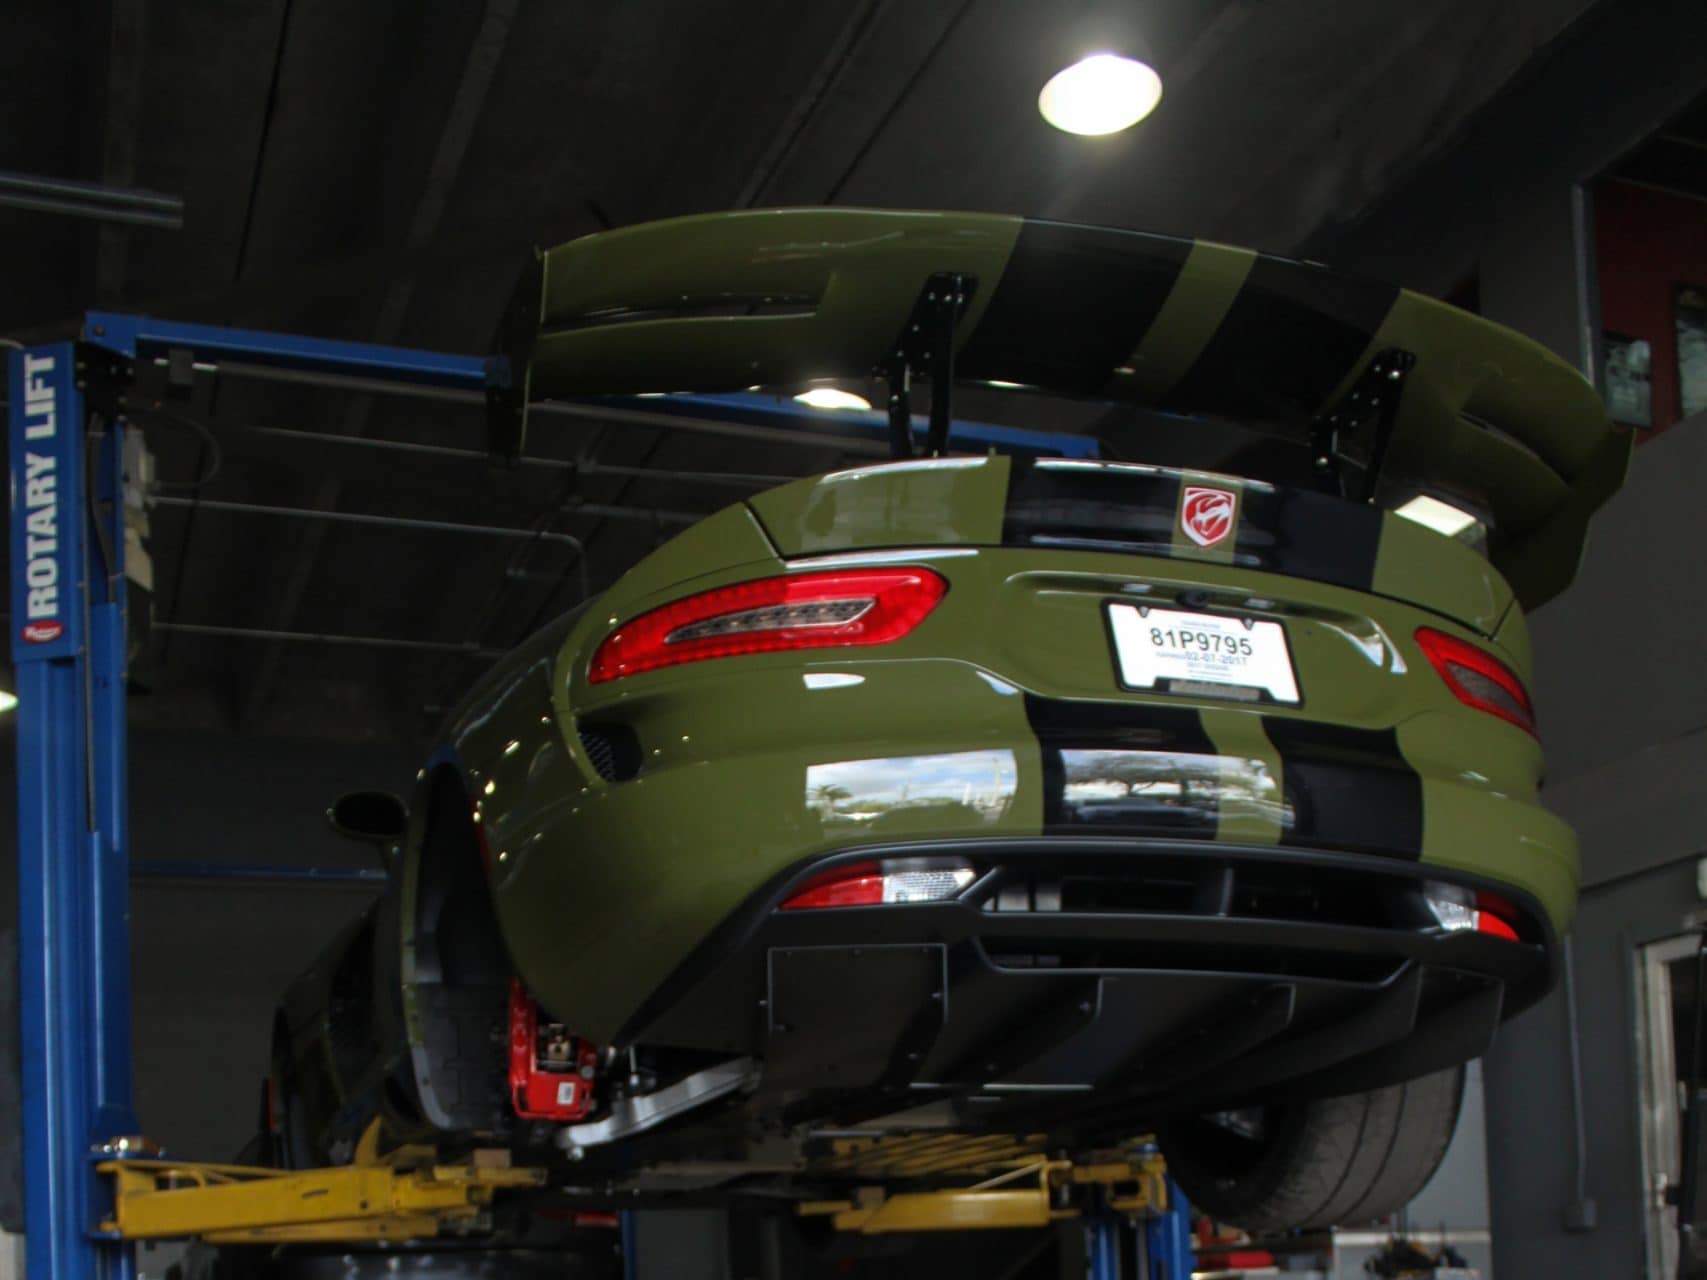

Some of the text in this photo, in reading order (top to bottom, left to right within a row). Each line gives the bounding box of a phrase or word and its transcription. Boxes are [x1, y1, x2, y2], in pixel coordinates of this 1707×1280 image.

[24, 353, 56, 440] LIFT
[25, 451, 59, 619] ROTARY
[1150, 627, 1253, 656] 81P9795
